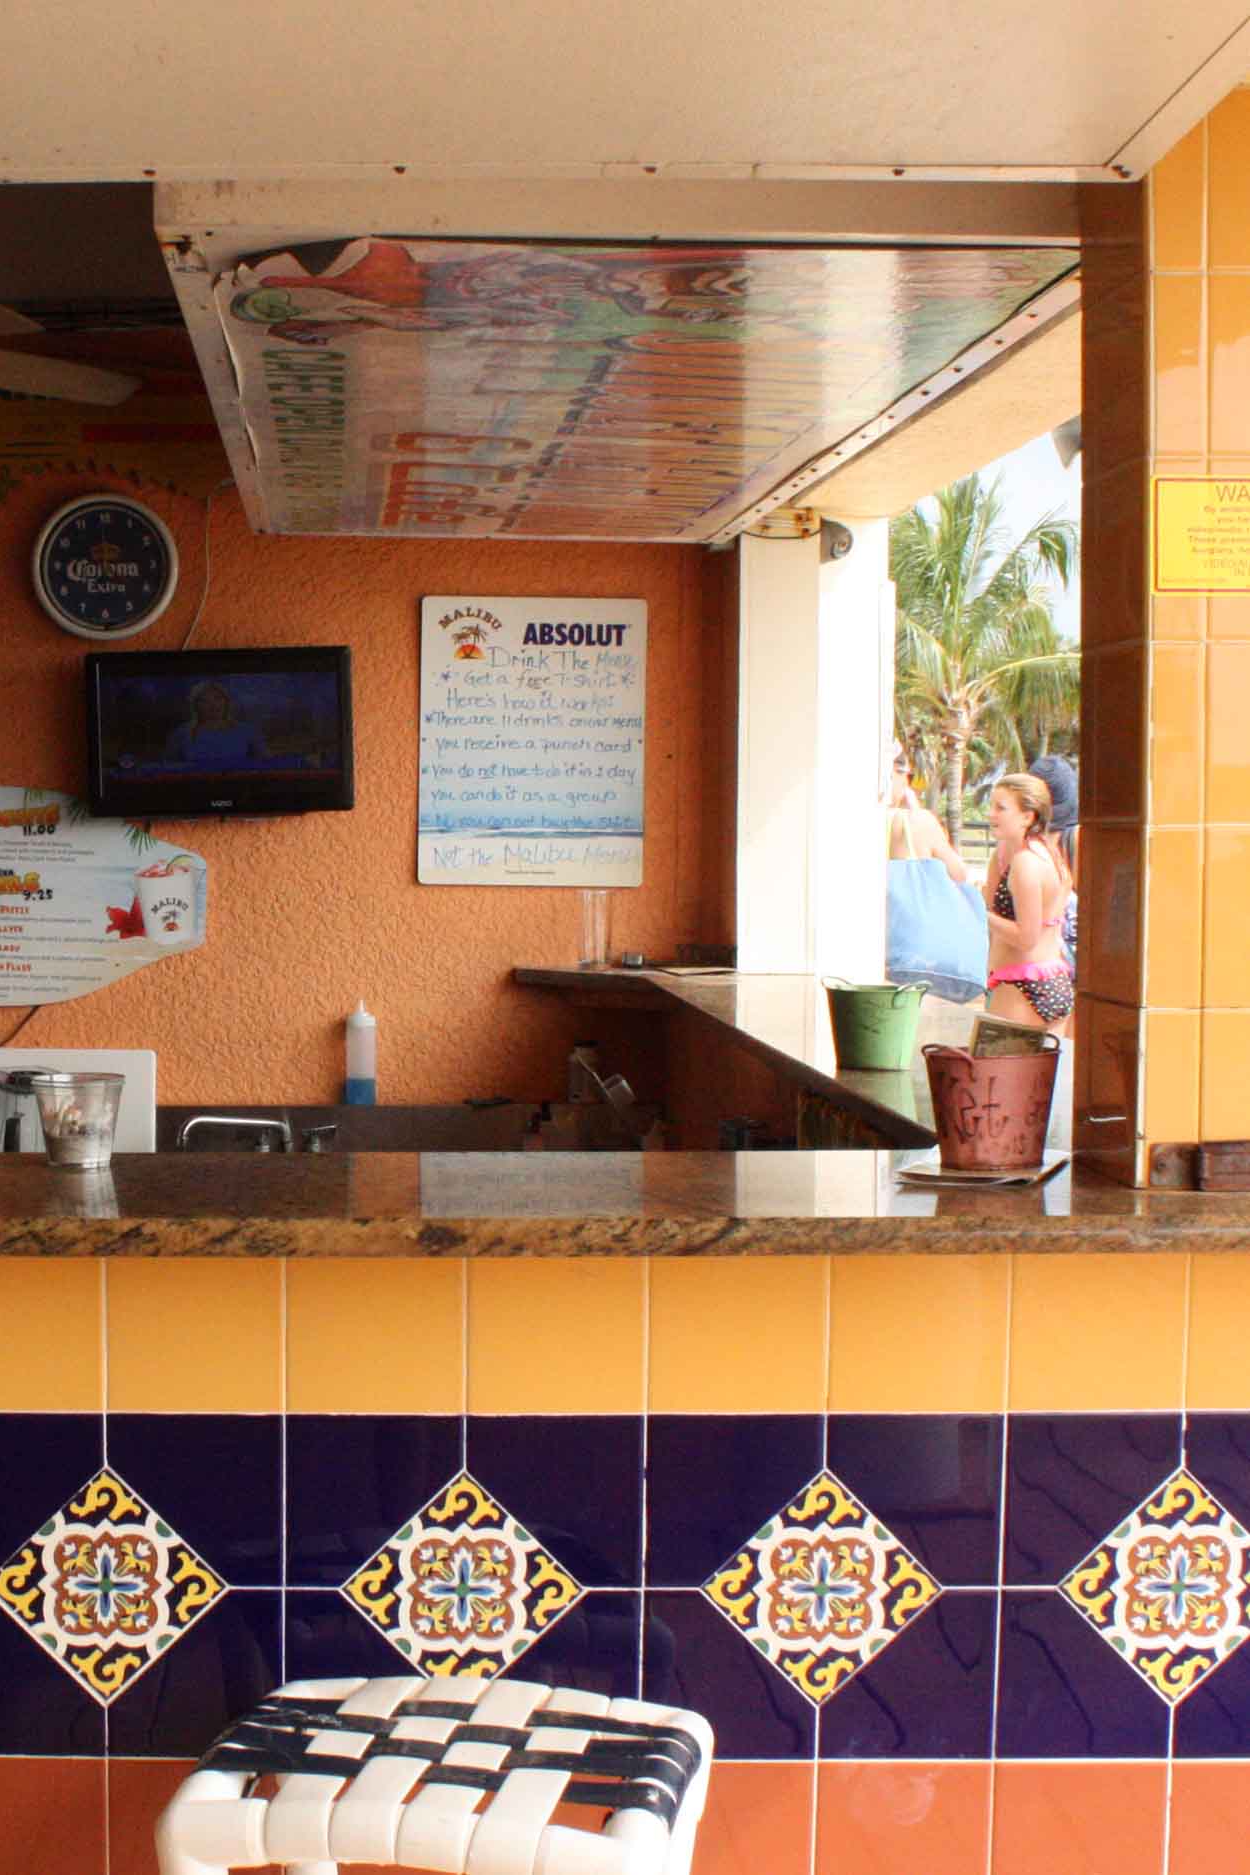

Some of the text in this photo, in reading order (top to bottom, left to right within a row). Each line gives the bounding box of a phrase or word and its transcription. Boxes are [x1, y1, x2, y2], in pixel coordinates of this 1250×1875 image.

[262, 349, 345, 393] CAFE
[269, 396, 345, 433] OPEN
[66, 560, 140, 582] Corona
[87, 579, 127, 593] Extra
[438, 605, 502, 630] MALIBU
[523, 623, 627, 646] ABSOLUT
[486, 646, 550, 668] Drink
[552, 650, 590, 669] The
[464, 671, 493, 686] Get
[447, 689, 497, 710] Here's
[502, 692, 536, 710] how
[464, 734, 521, 752] receive
[542, 739, 592, 756] punch
[594, 737, 633, 754] card
[456, 764, 473, 777] do
[477, 763, 498, 778] not
[607, 765, 638, 785] day
[23, 824, 57, 836] 11.00
[433, 845, 461, 868] Not
[22, 889, 53, 901] 9.25
[151, 897, 189, 914] MALIBU
